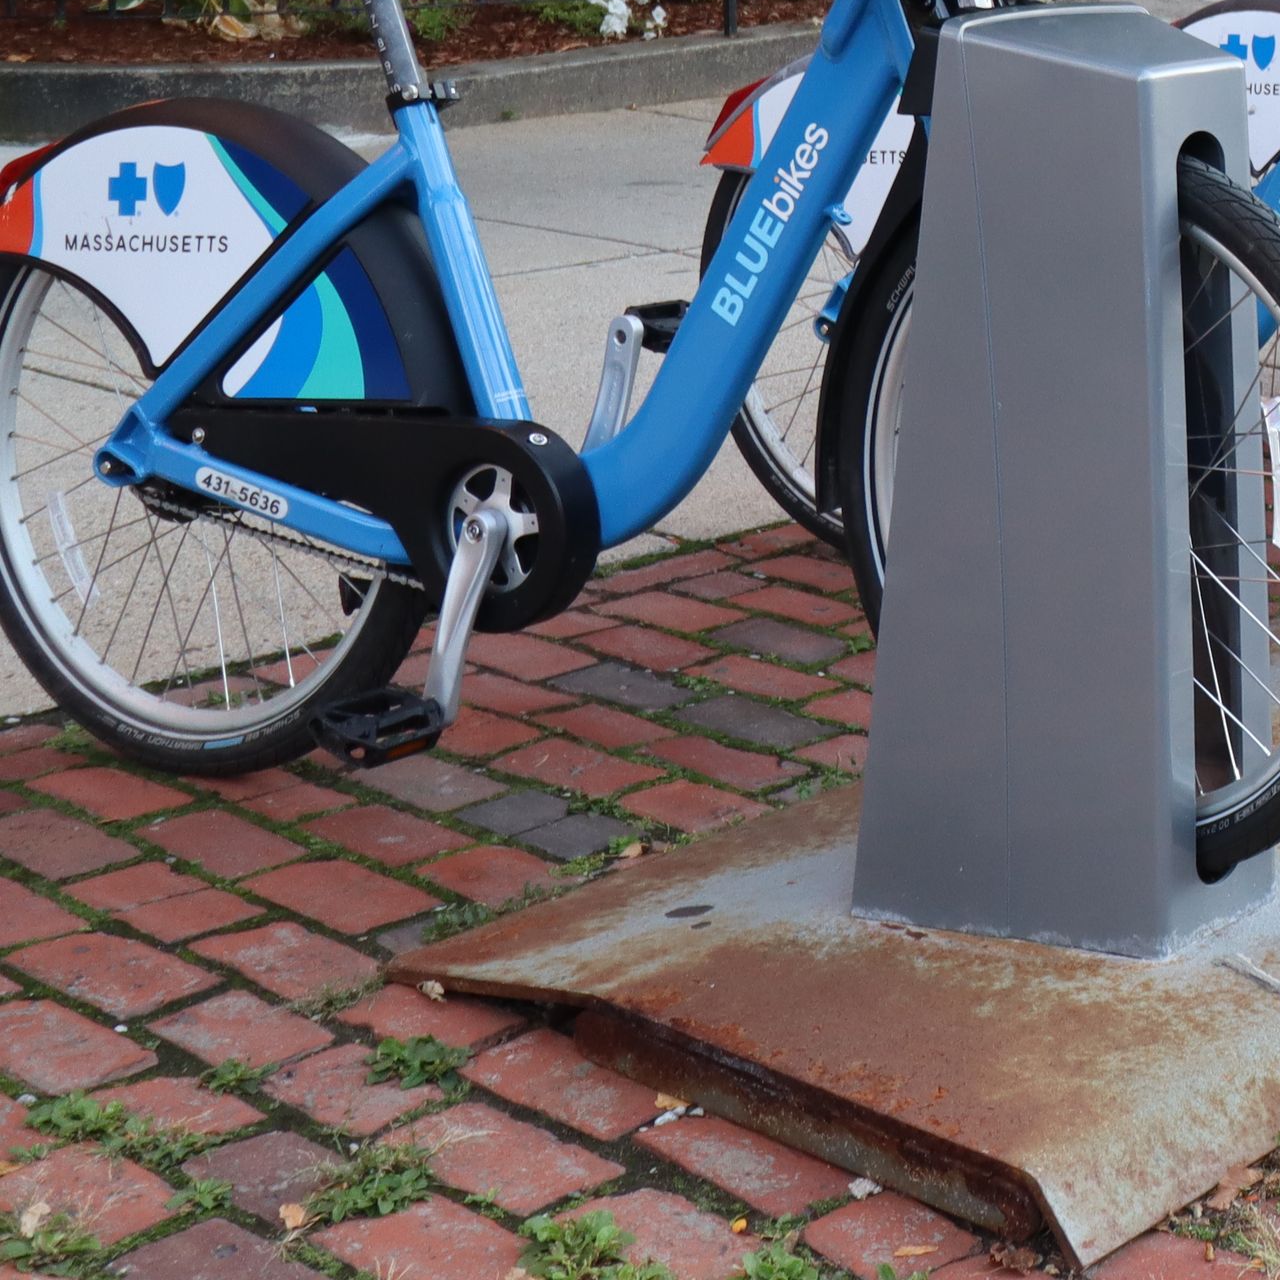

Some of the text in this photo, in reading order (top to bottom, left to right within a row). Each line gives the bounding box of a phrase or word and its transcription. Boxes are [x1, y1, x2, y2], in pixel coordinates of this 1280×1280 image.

[64, 233, 229, 253] MASSACHUSETTS
[711, 122, 829, 327] BLUEbikes
[886, 265, 917, 312] SCHWAL
[202, 474, 282, 517] 431-5636
